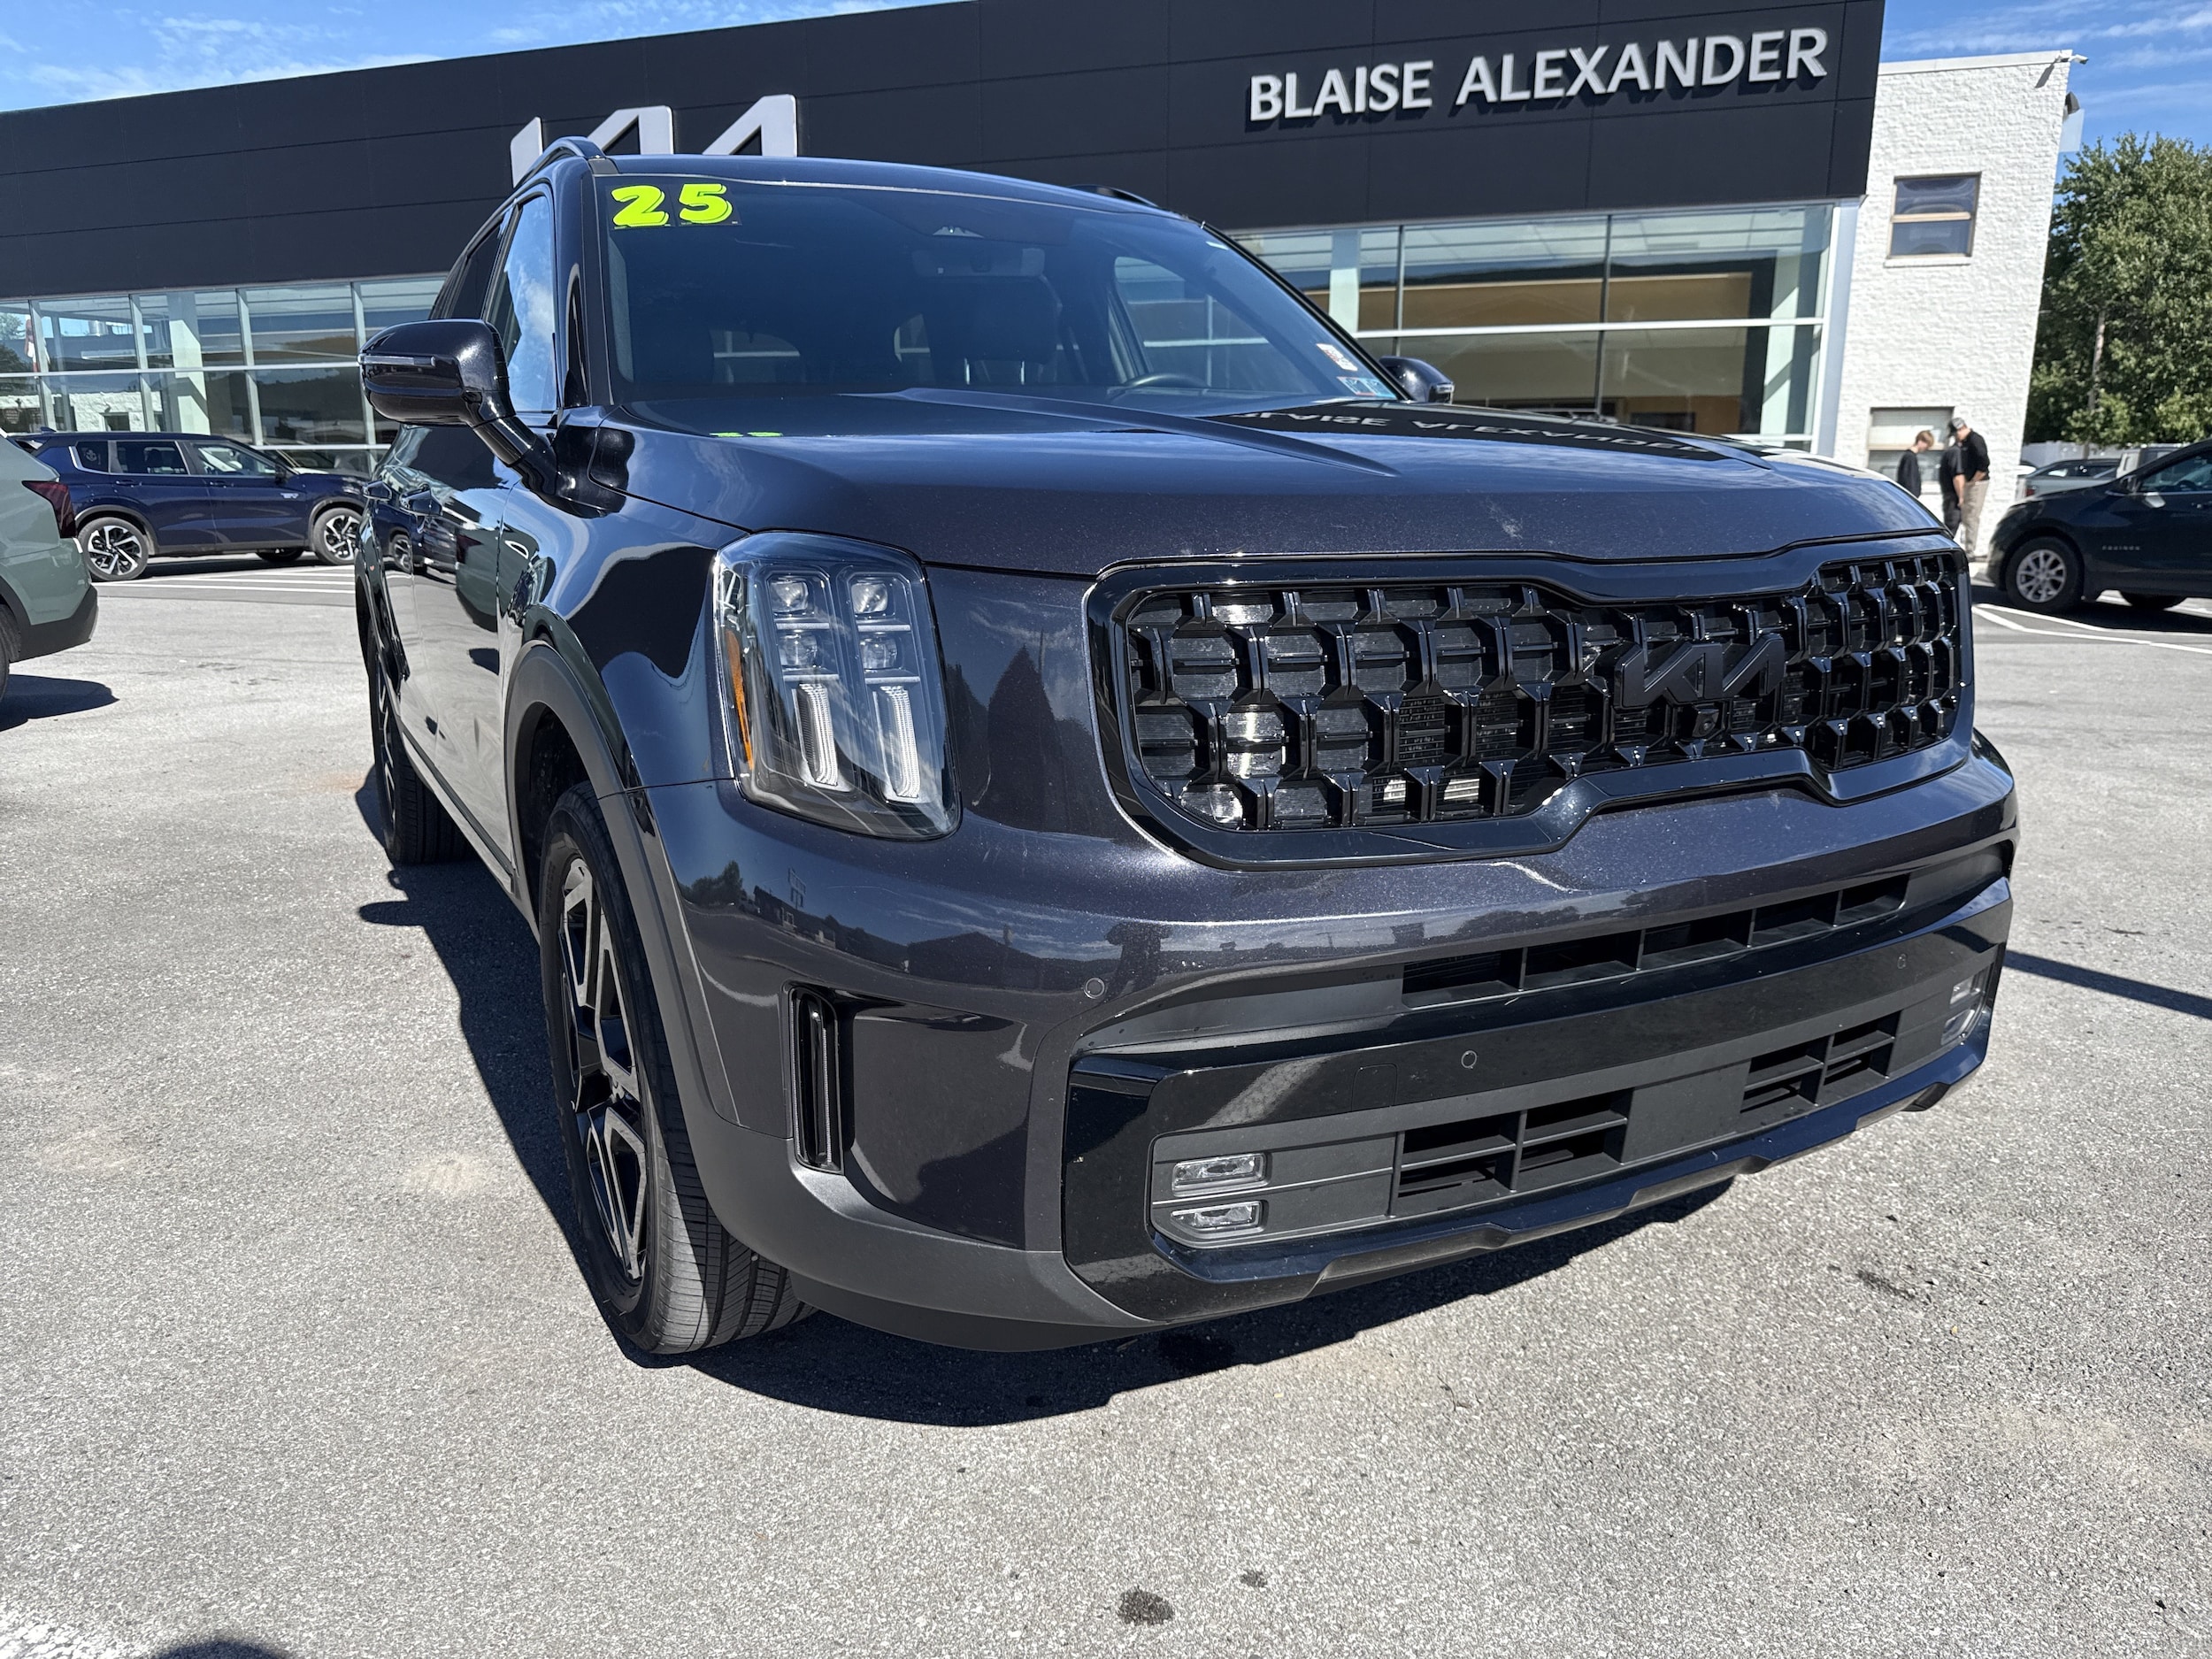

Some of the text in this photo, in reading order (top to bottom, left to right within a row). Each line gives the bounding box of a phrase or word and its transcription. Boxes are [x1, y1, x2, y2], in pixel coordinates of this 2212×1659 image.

[1249, 27, 1828, 121] BLAISE ALEXANDER
[611, 183, 733, 227] 25
